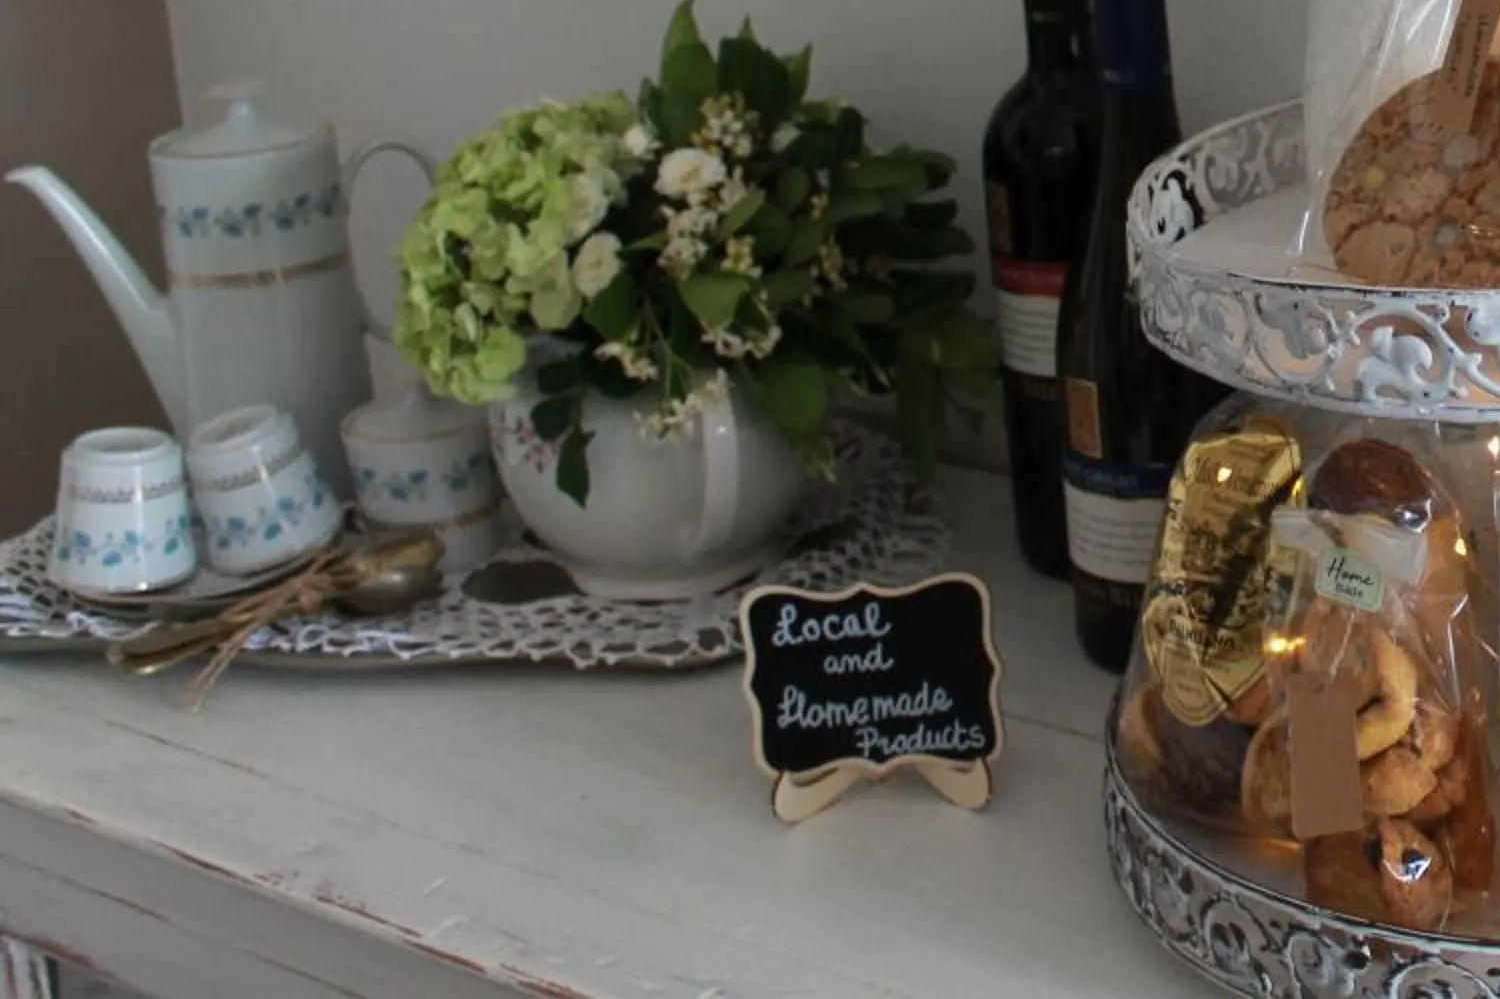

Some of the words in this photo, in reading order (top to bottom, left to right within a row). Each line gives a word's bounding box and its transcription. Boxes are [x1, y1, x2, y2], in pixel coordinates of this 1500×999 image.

[1325, 556, 1374, 586] Home
[772, 602, 892, 647] Local
[824, 642, 895, 674] and
[777, 682, 953, 729] Homemade
[855, 717, 986, 758] Products
